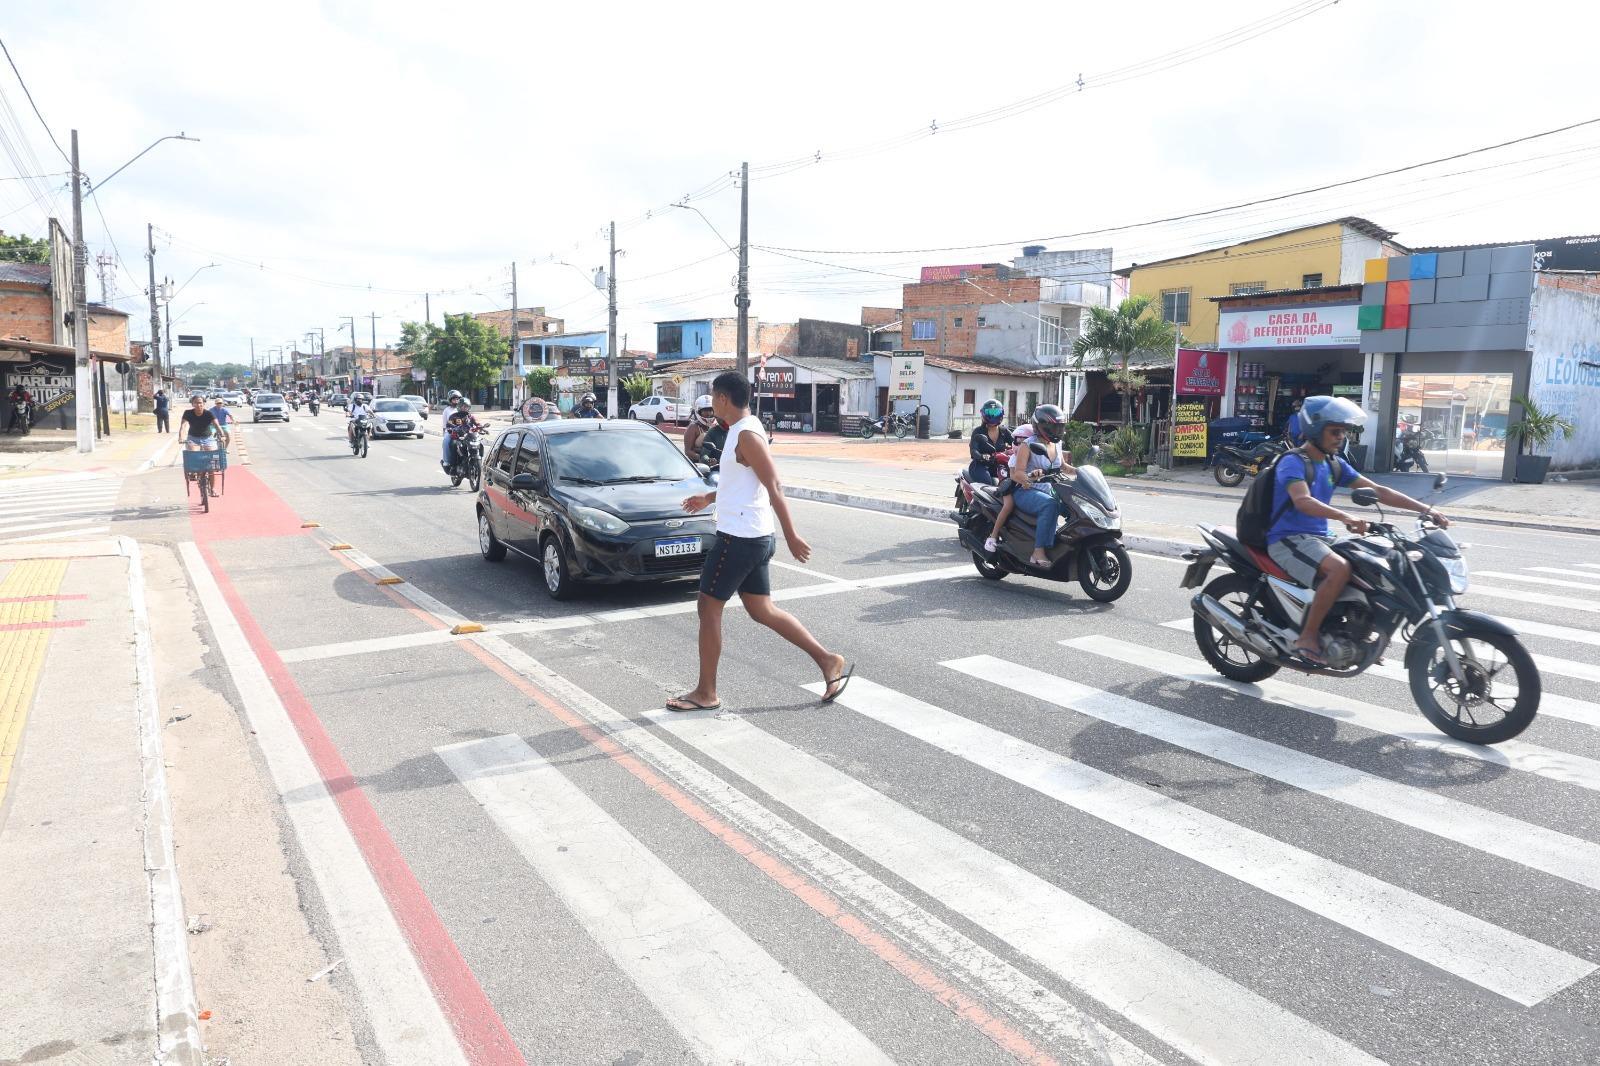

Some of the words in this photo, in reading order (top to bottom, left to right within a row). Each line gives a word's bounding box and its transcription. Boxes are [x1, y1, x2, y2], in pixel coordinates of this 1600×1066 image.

[1268, 314, 1298, 326] CASA
[1302, 311, 1318, 324] DA
[1253, 323, 1333, 337] REFRIGERAÇÃO
[9, 375, 72, 388] MARLON
[1175, 424, 1205, 434] OMPRO
[1174, 434, 1200, 442] ELADEIRA
[659, 543, 696, 555] NST2133
